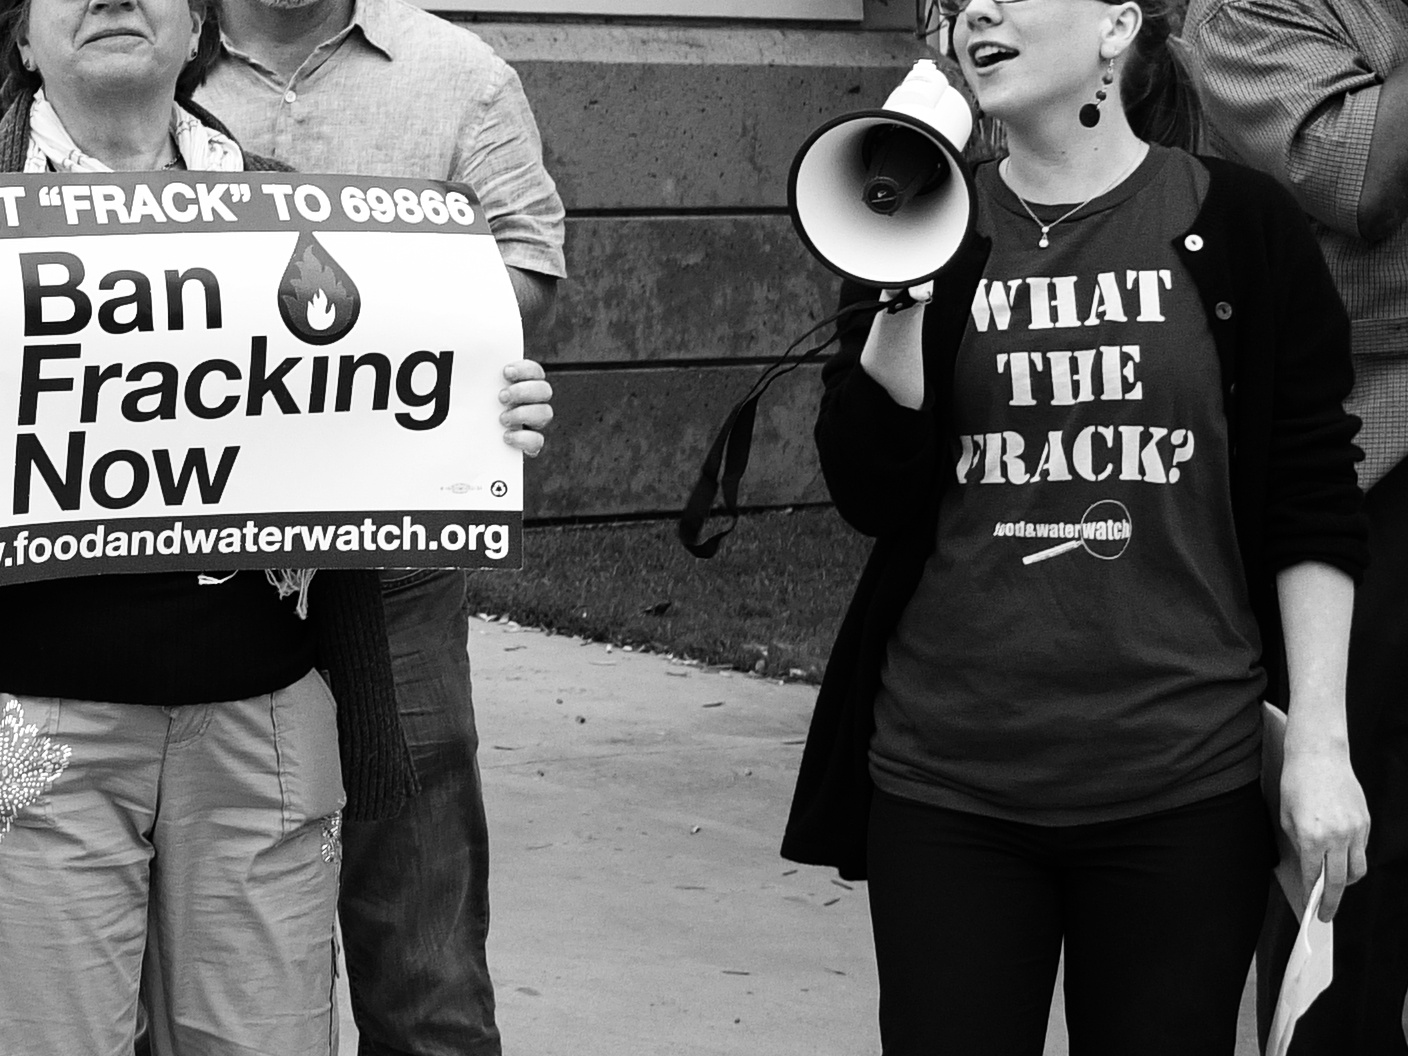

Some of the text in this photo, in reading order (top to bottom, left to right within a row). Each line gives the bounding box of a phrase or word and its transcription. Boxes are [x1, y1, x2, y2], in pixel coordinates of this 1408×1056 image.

[262, 184, 332, 222] TO
[341, 187, 475, 226] 69866
[19, 251, 222, 336] Ban
[971, 270, 1172, 332] WHAT
[18, 336, 454, 431] Fracking
[996, 345, 1143, 406] THE
[13, 431, 240, 515] Now
[956, 426, 1195, 484] FRACK?
